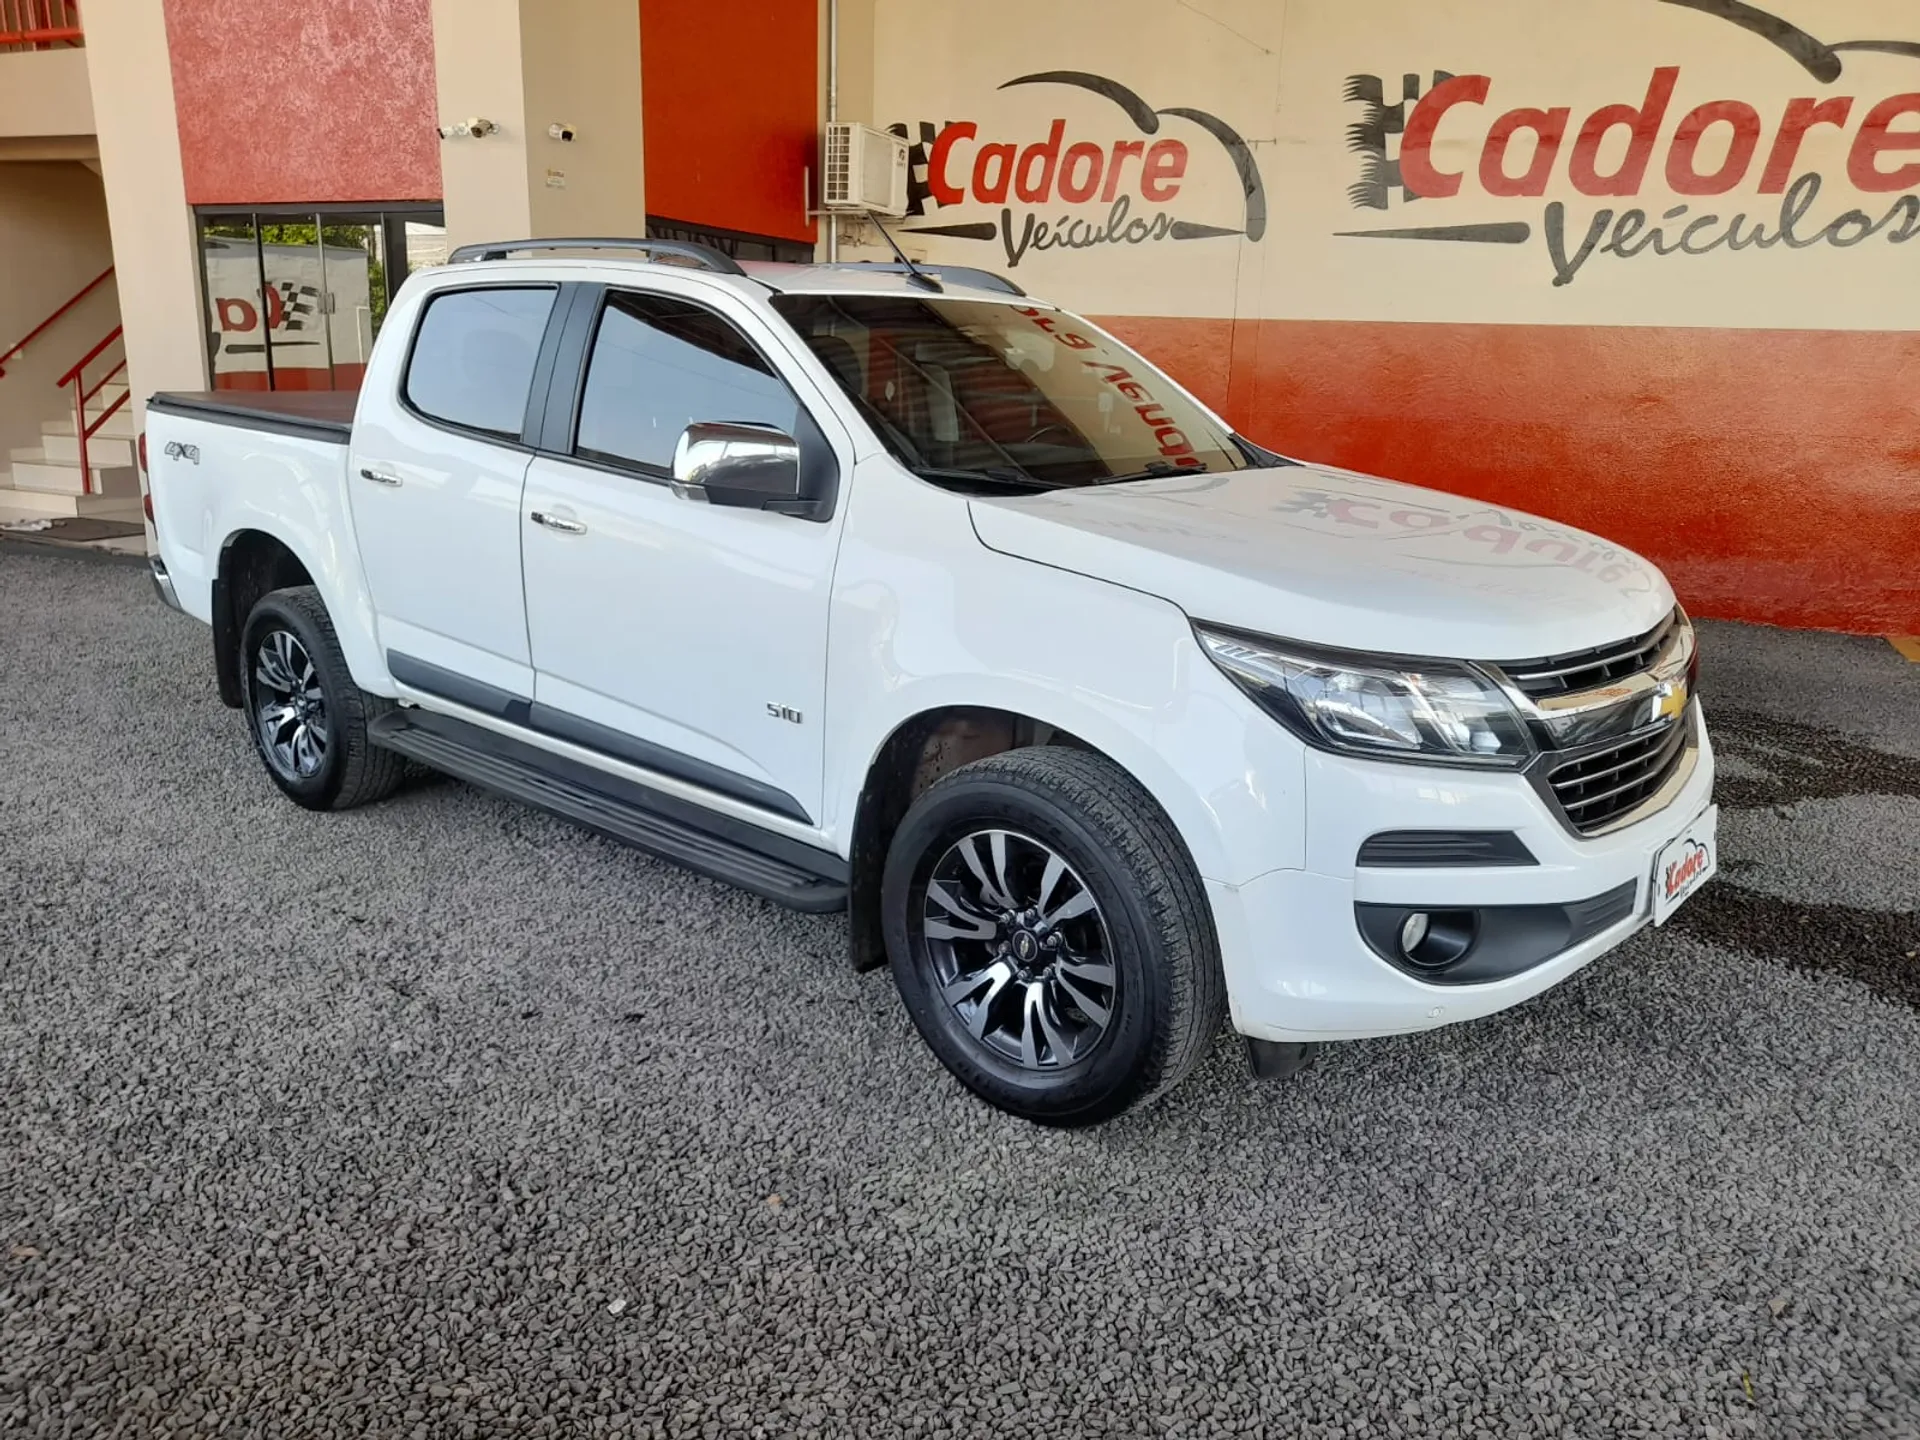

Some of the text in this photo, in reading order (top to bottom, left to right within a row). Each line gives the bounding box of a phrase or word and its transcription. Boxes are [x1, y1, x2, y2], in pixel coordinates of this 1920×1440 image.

[928, 119, 1188, 204] Cadore
[1400, 66, 1920, 197] Cadore
[1002, 195, 1174, 267] Veículos
[1544, 172, 1920, 287] Veículos
[766, 701, 802, 724] S10
